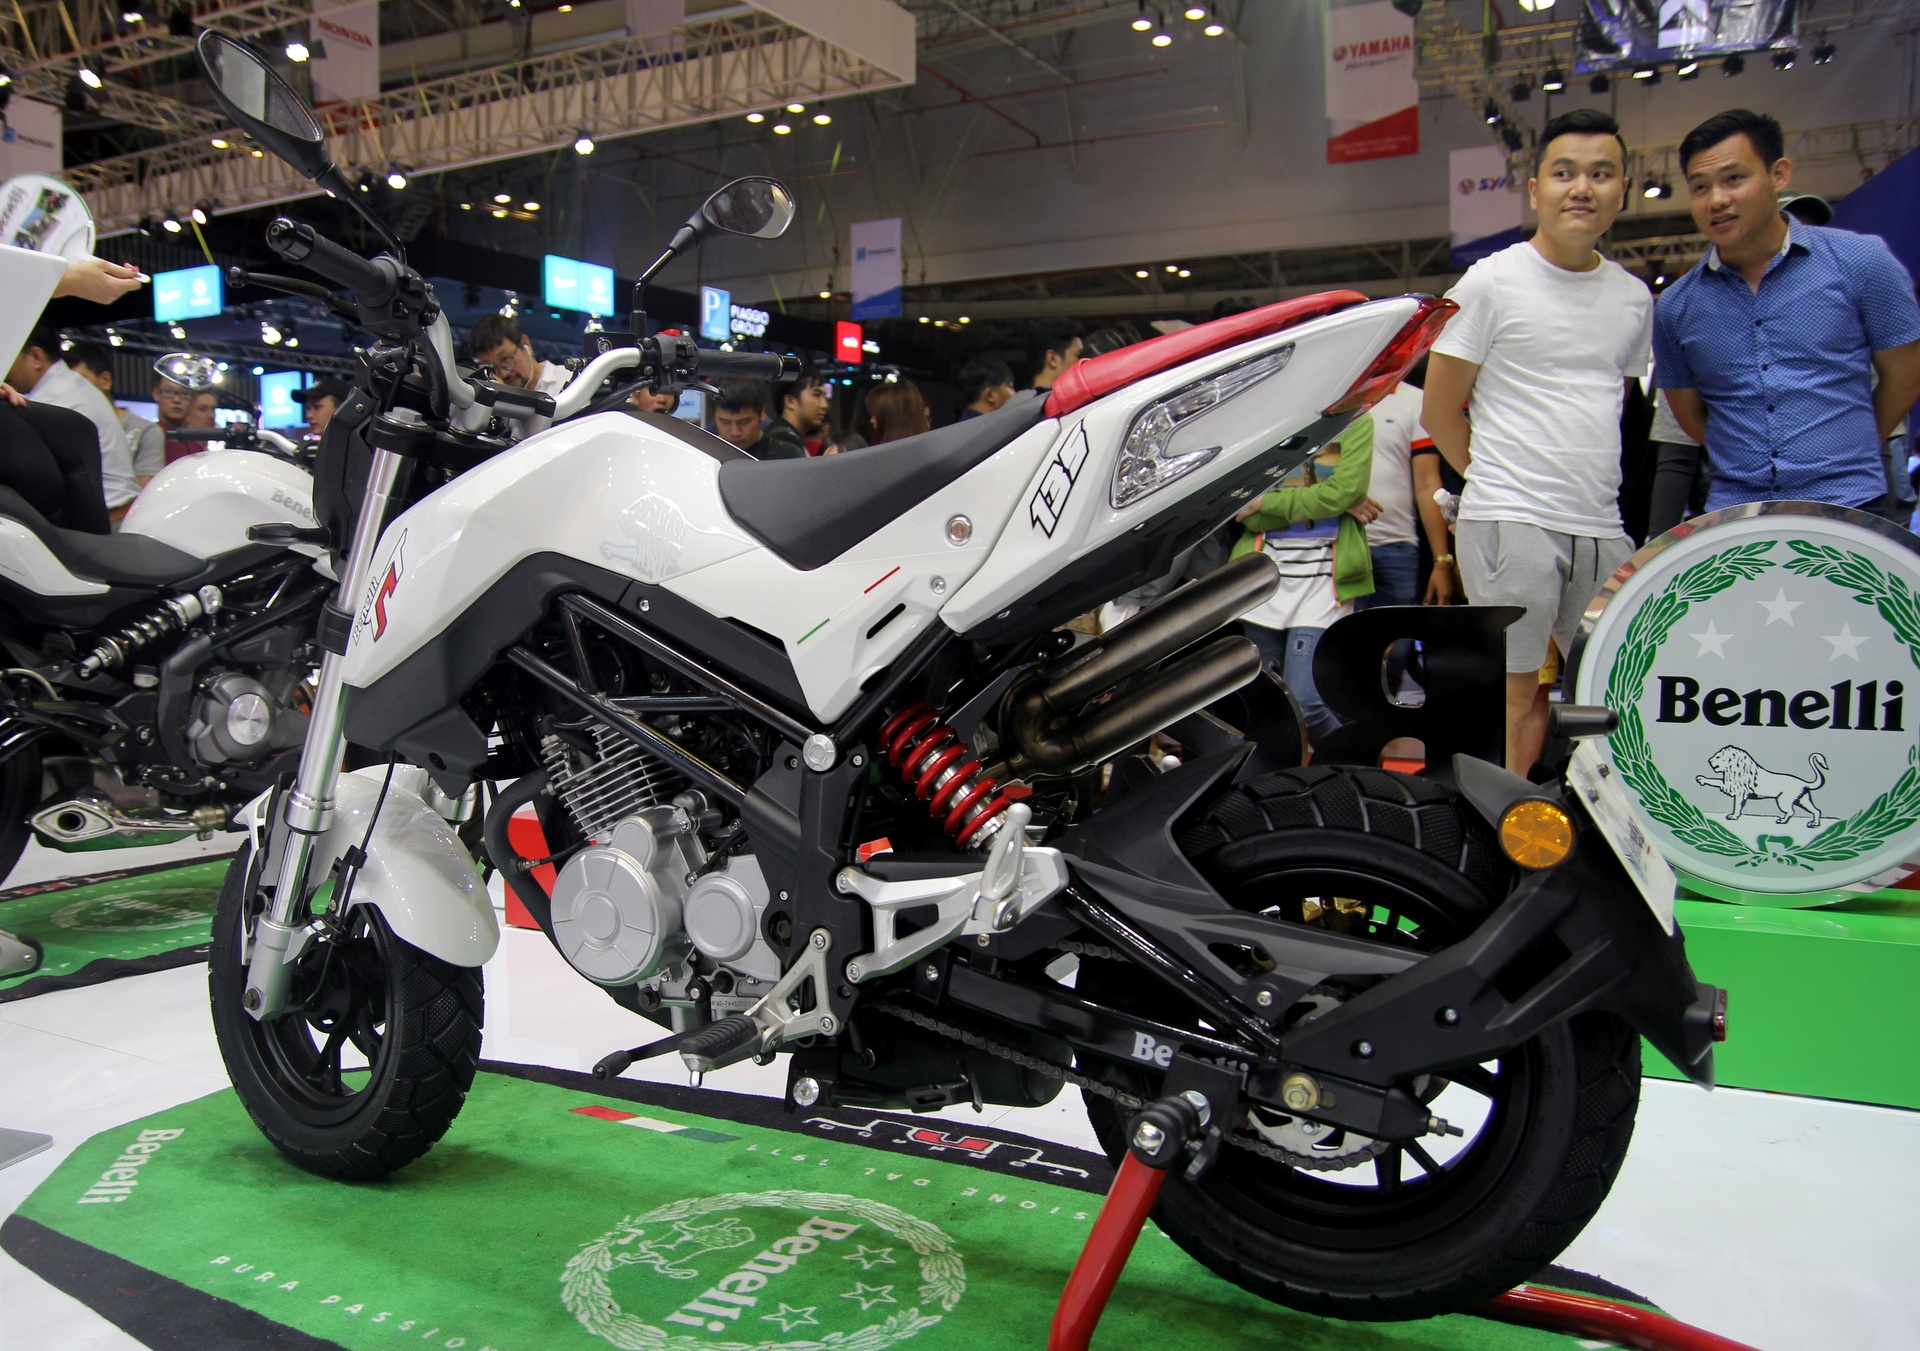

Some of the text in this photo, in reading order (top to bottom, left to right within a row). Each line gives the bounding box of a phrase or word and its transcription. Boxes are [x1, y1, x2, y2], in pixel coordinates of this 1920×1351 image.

[1350, 35, 1411, 58] YAMAHA
[730, 304, 770, 326] PIAGGIO
[730, 319, 766, 338] GROUP
[271, 487, 314, 522] Bene
[352, 576, 380, 647] Benelli
[1655, 675, 1905, 731] Benelli
[76, 1127, 186, 1205] Benelli
[864, 1166, 931, 1187] DAL
[209, 1255, 300, 1291] PURA
[664, 1215, 862, 1333] Benelli
